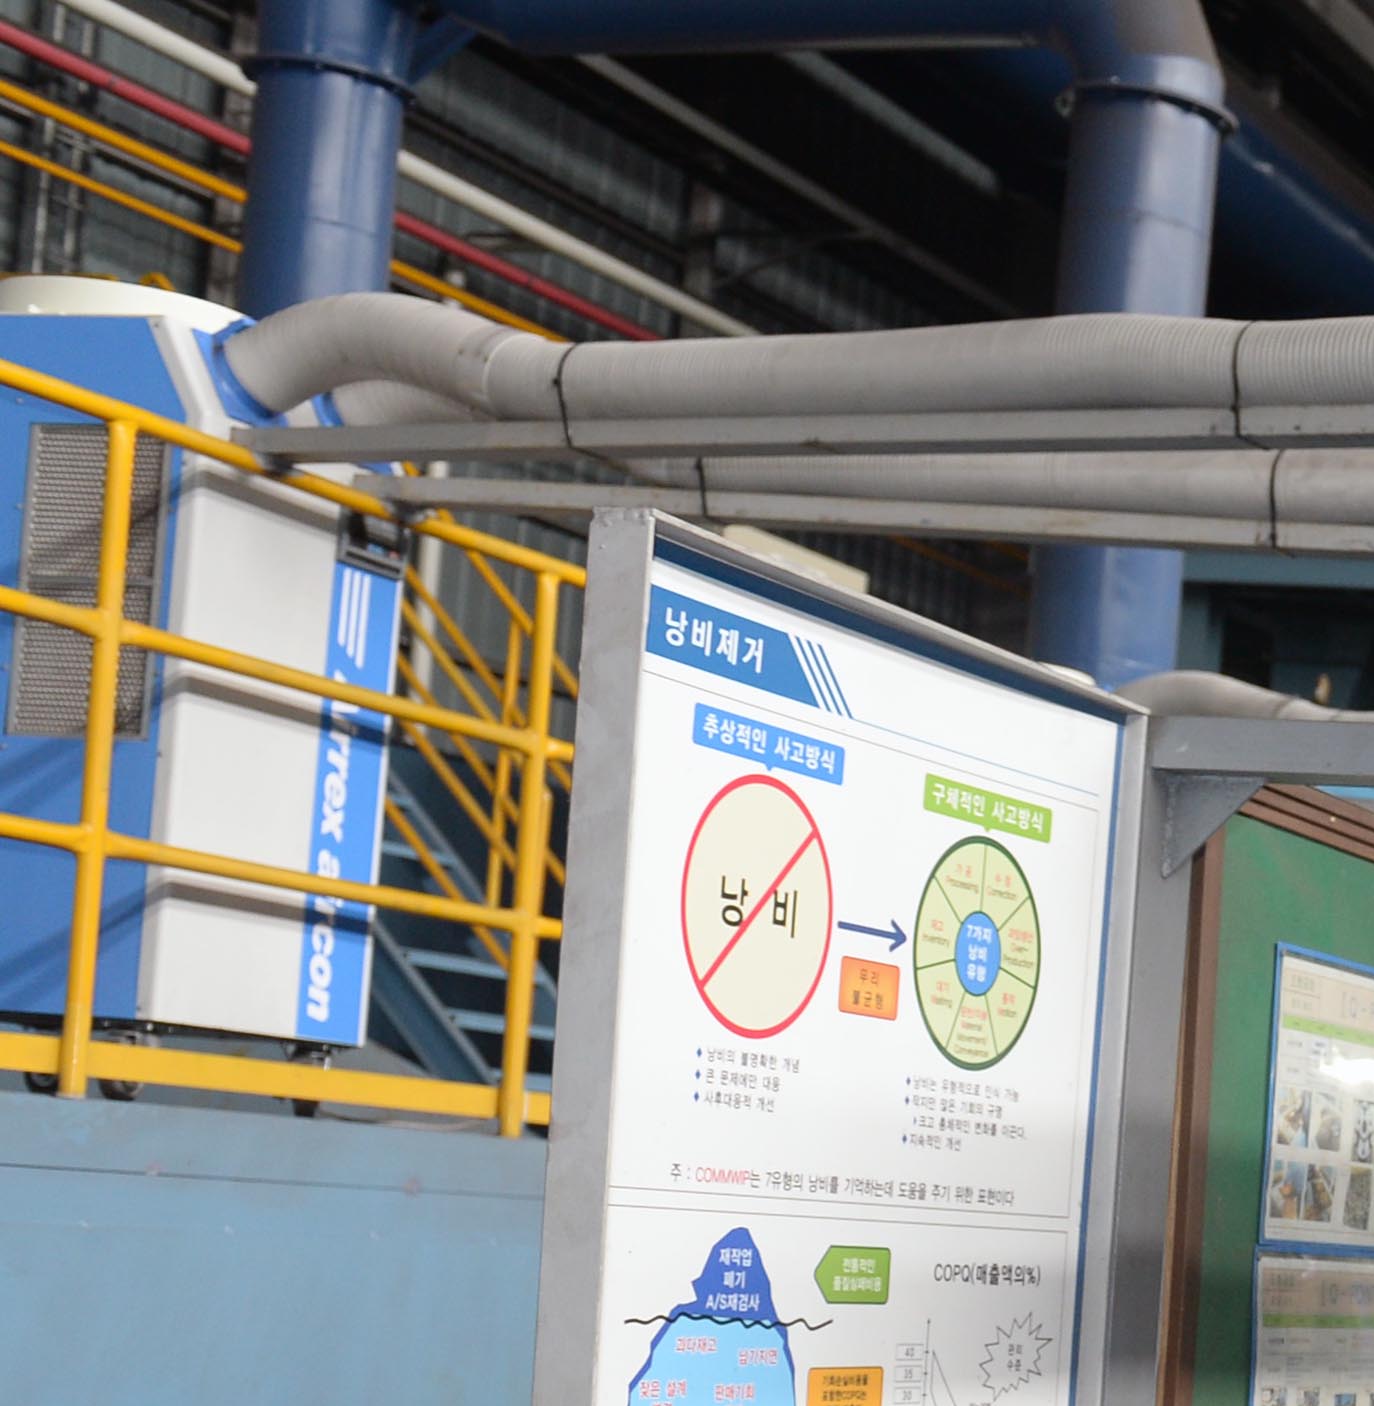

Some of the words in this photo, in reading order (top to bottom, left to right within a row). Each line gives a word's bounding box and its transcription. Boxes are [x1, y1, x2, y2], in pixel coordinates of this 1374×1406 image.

[665, 607, 764, 674] 낭비제거
[702, 713, 767, 754] 추상적인
[774, 736, 836, 774] 사고방식
[932, 783, 985, 817] 구체적인
[992, 801, 1044, 833] 사고방식
[967, 924, 992, 944] 7가지
[968, 944, 988, 962] 낭비
[967, 963, 987, 982] 유형
[765, 1170, 803, 1191] 7유형의
[809, 1174, 838, 1194] 낭비를
[898, 1181, 927, 1201] 도움을
[719, 1248, 752, 1267] 재작업
[842, 1258, 876, 1273] 전통적인
[723, 1271, 746, 1289] 폐기
[933, 1263, 1041, 1286] COPQ(매출액의%)
[833, 1276, 882, 1293] 품질실패비용
[705, 1293, 760, 1312] A/S재검사
[676, 1336, 717, 1353] 과다재고
[739, 1349, 778, 1365] 납기지연
[640, 1381, 660, 1398] 잦은
[715, 1384, 755, 1400] 판매기회
